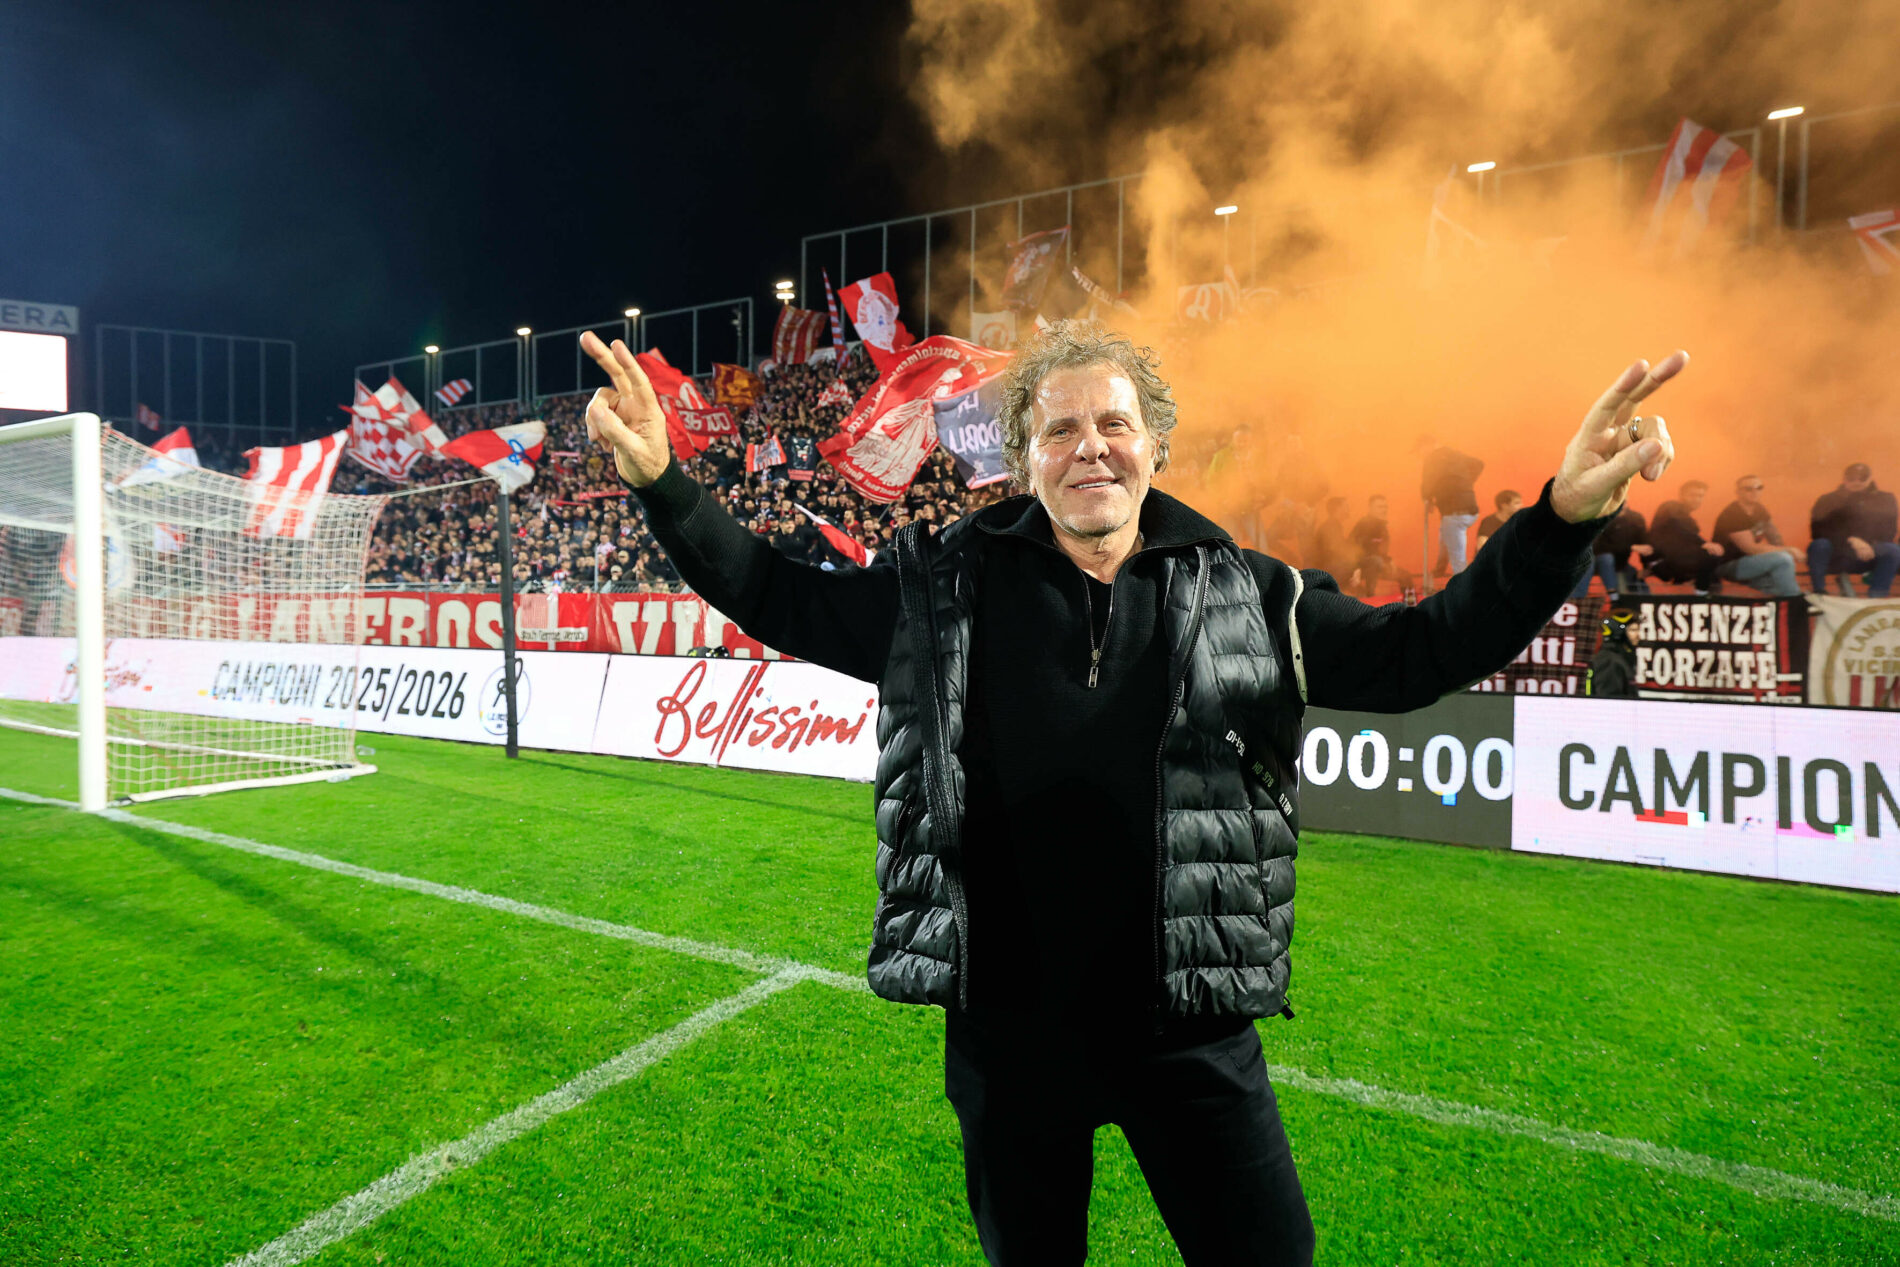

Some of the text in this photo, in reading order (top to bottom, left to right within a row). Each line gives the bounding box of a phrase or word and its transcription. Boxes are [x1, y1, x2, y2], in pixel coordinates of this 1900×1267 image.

[1638, 602, 1772, 645] ASSENZE
[213, 659, 323, 706] CAMPIONI
[323, 663, 468, 722] 2025/2026
[1635, 646, 1777, 690] FORZATE
[654, 659, 875, 765] Bellissimi
